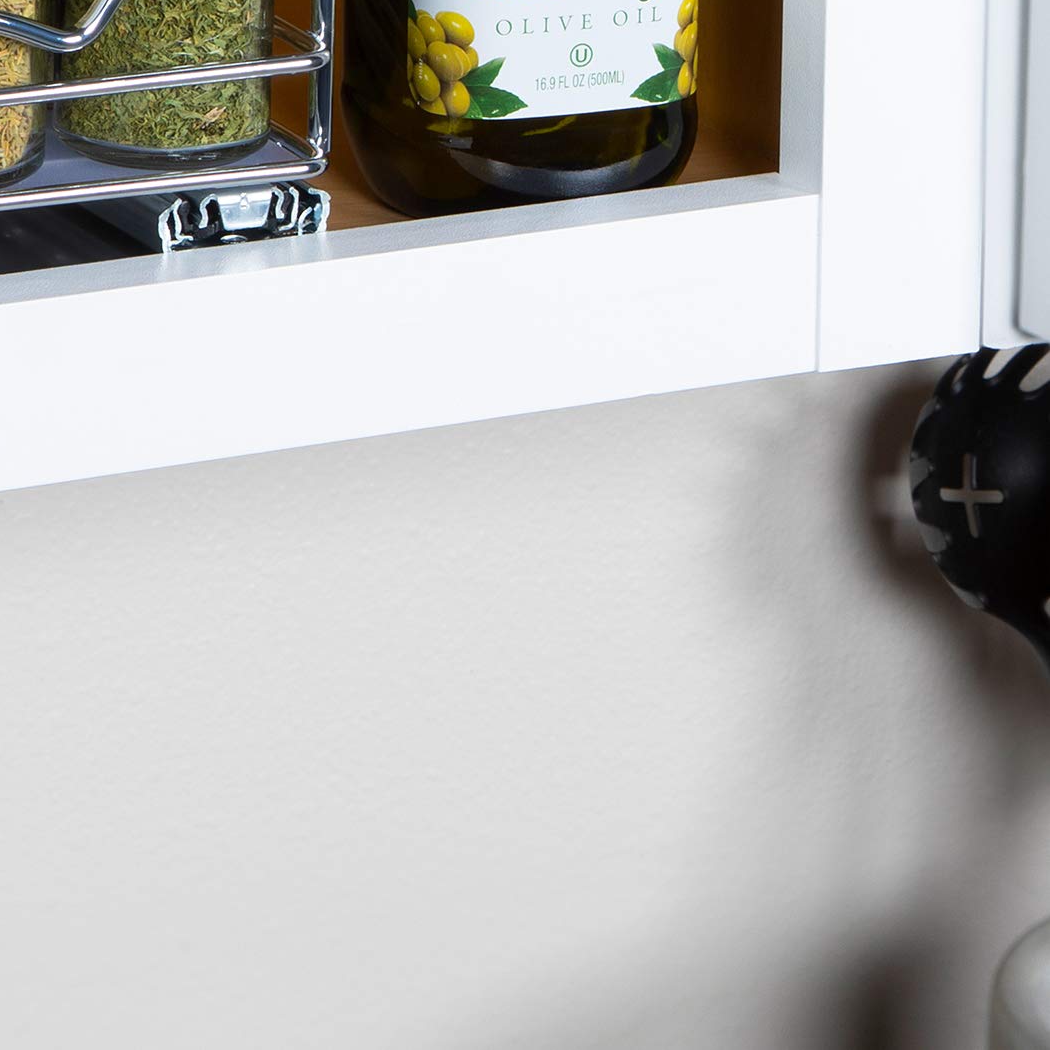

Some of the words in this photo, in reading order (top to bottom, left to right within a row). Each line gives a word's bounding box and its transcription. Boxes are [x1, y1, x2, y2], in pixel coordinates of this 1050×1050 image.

[495, 14, 593, 36] OLIVE
[612, 6, 662, 27] OIL
[535, 76, 556, 91] 16.9
[558, 75, 570, 89] FL
[572, 73, 585, 88] OZ
[587, 69, 625, 88] (500ML)
